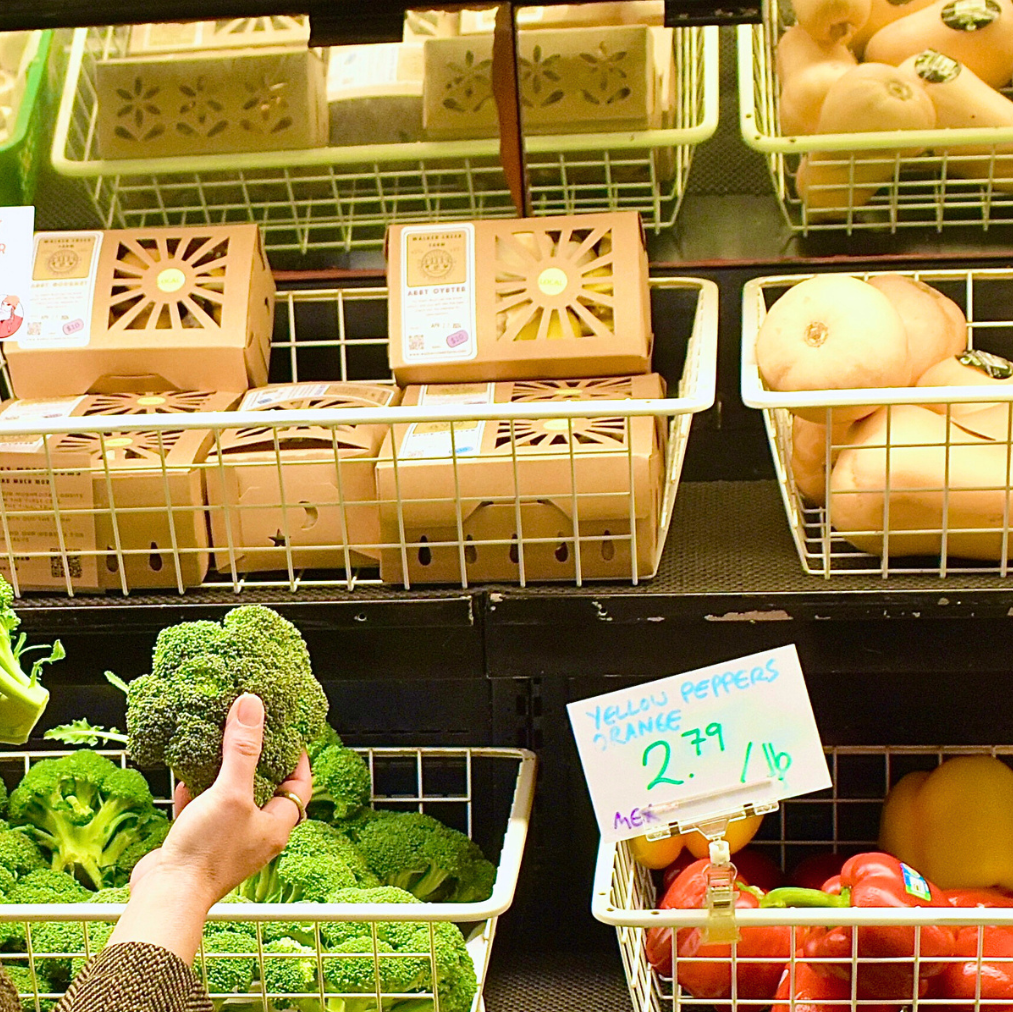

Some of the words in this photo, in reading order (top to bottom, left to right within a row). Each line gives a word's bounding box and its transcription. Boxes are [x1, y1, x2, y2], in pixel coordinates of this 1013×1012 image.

[586, 691, 668, 730] YELLOW
[680, 658, 779, 703] PEPPERS
[593, 709, 682, 752] ORANGE
[642, 722, 725, 791] 2.79
